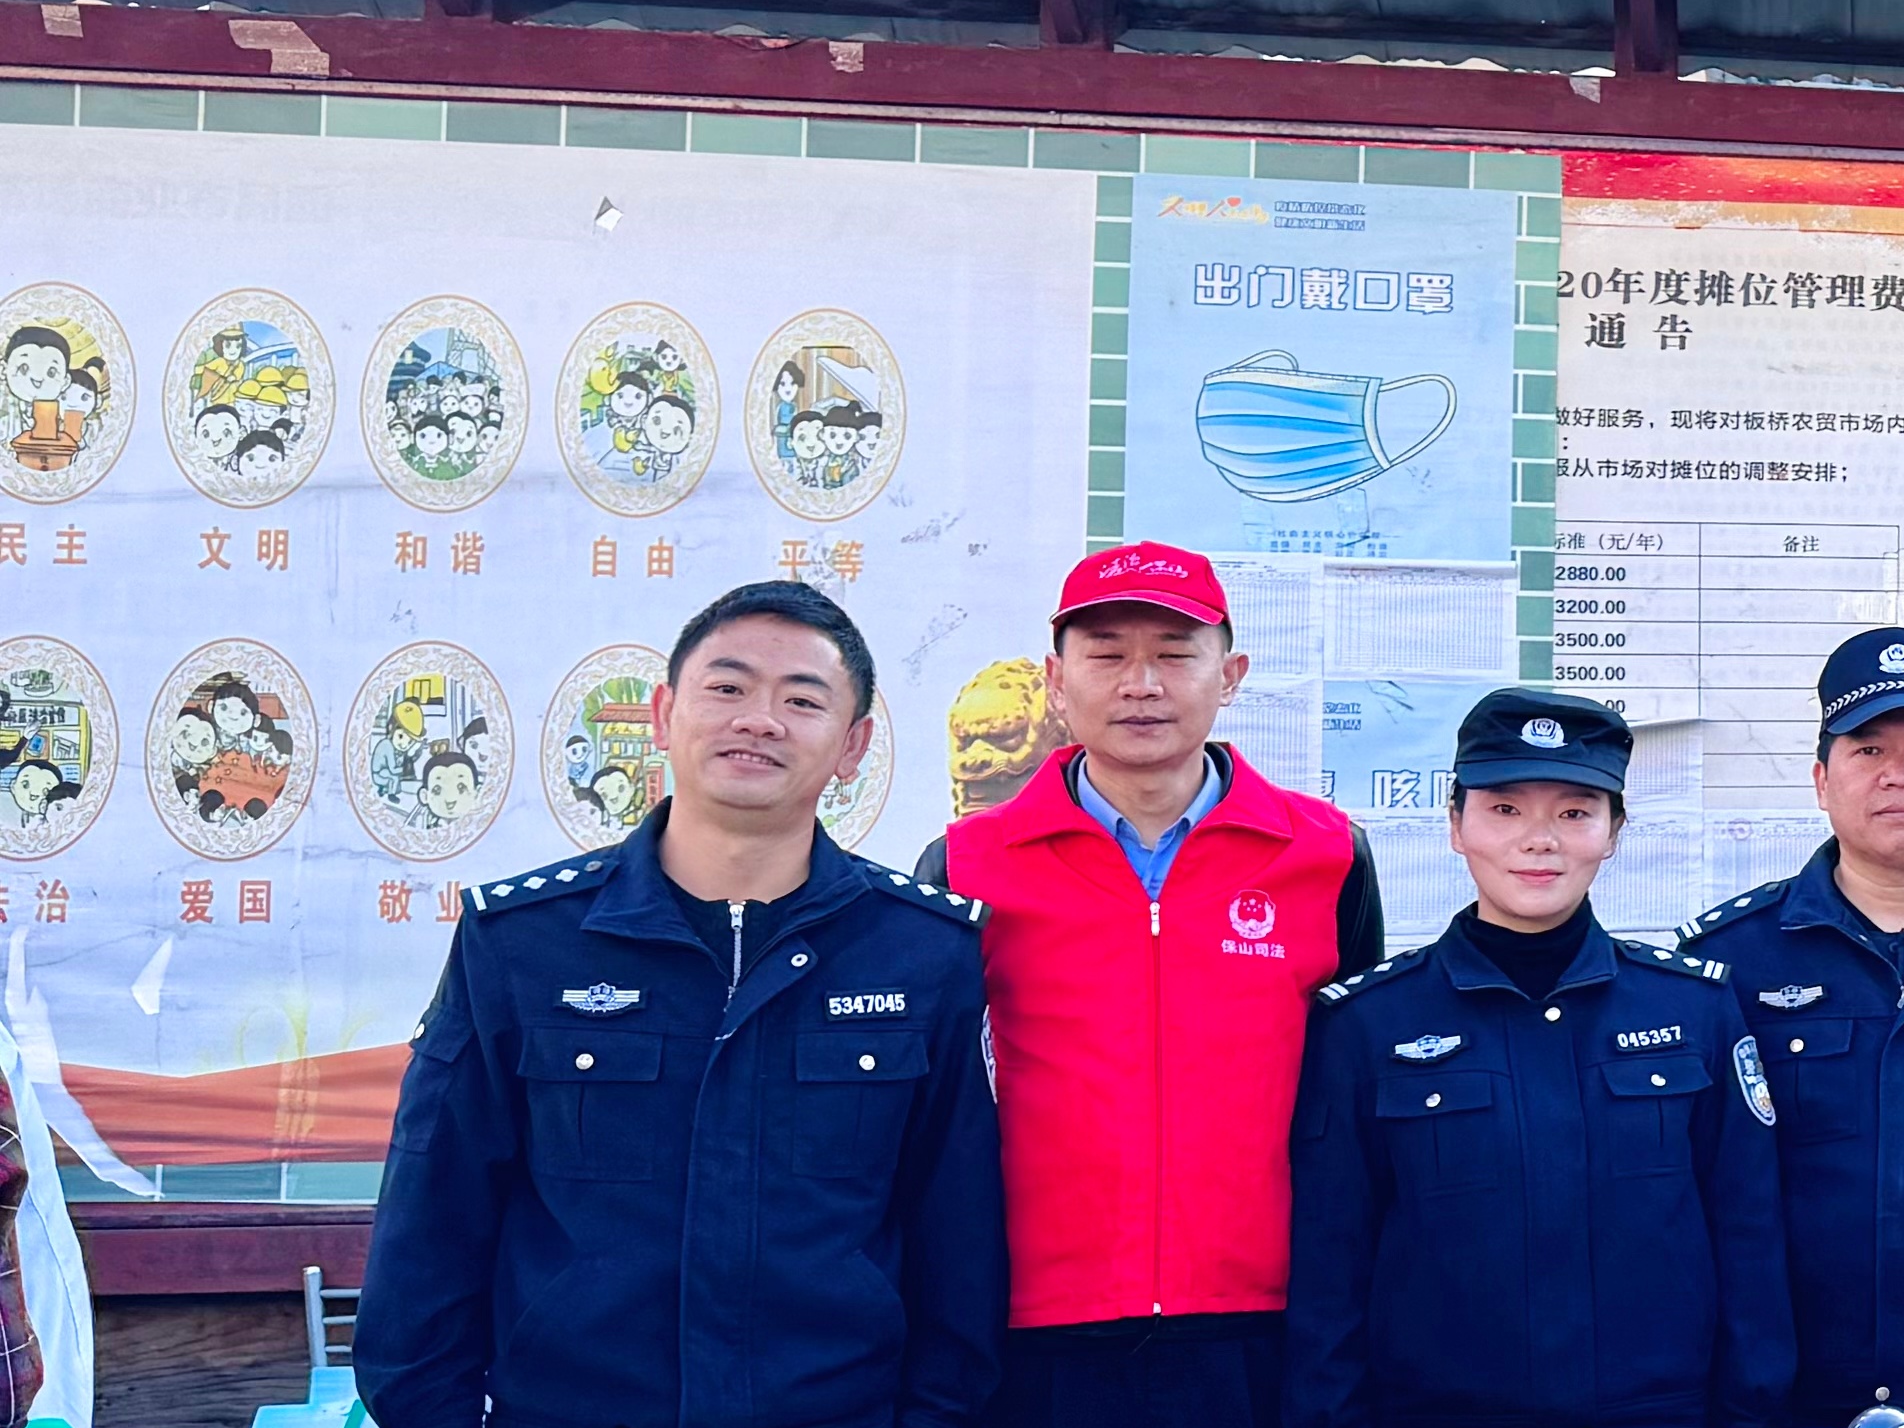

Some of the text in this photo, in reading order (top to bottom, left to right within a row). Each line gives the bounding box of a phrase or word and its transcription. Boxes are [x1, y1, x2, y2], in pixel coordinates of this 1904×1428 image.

[1194, 262, 1454, 316] 出门戴口罩
[1584, 313, 1695, 351] 通告
[0, 523, 88, 566] 民主
[198, 526, 290, 571] 文明
[395, 531, 486, 575] 和谐
[591, 536, 675, 579] 自由
[777, 537, 864, 584] 平等
[1782, 533, 1820, 554] 备注
[1554, 566, 1626, 583] 2880.00
[1554, 599, 1626, 616] 3200.00
[1554, 632, 1626, 650] 3500.00
[1554, 665, 1626, 682] 3500.00
[180, 880, 272, 924] 爱国
[378, 880, 463, 924] 敬业
[1221, 939, 1285, 960] 保山司法
[829, 993, 906, 1016] 5347045
[1617, 1025, 1682, 1050] 045357
